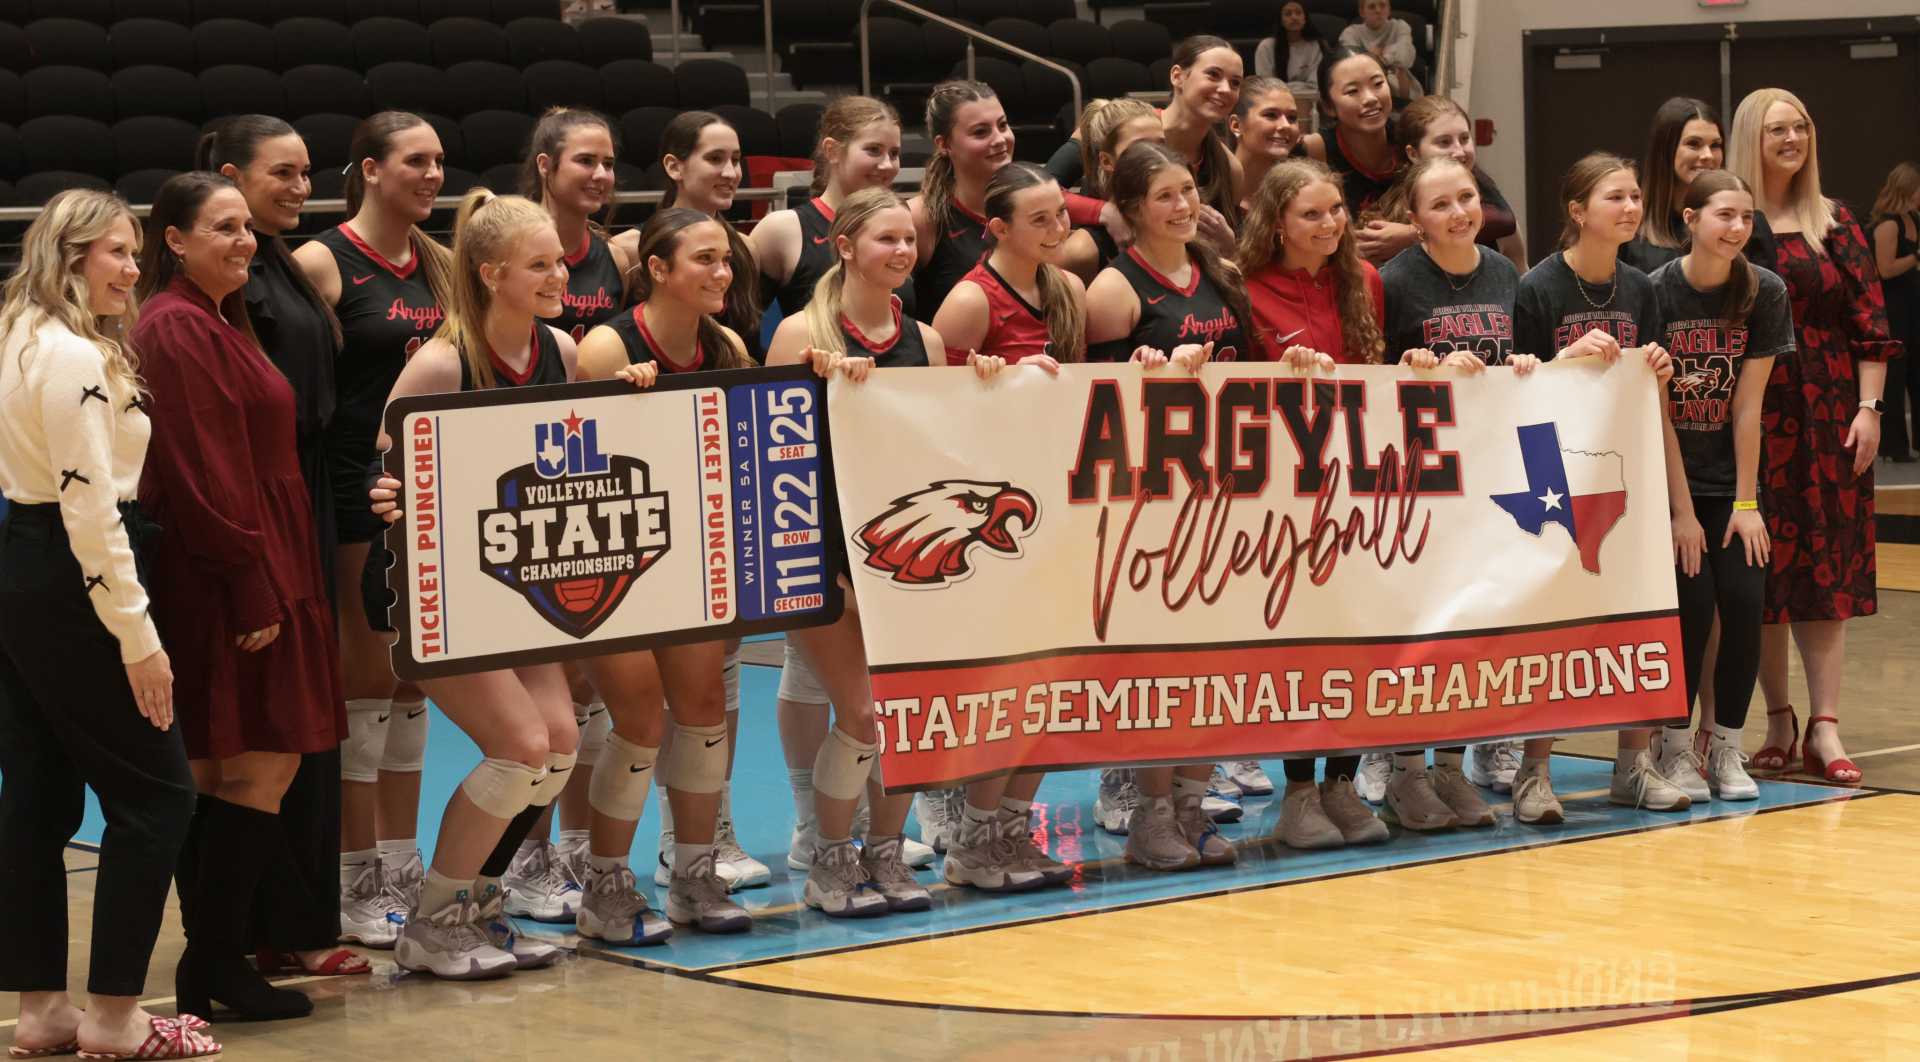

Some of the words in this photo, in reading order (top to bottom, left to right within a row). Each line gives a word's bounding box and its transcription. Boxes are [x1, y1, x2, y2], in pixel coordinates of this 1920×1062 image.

[386, 297, 445, 330] Argyl
[1177, 306, 1237, 342] Argyle
[701, 392, 723, 482] TICKET
[738, 421, 748, 447] D2
[767, 387, 815, 444] 25
[1669, 399, 1728, 423] LAYO
[535, 410, 609, 478] UIL
[779, 446, 806, 459] SEAT
[1068, 378, 1463, 504] ARGYLE
[414, 417, 437, 550] PUNCHED
[525, 478, 624, 505] VOLLEYBALL
[772, 471, 819, 529] 22
[483, 495, 667, 565] STATE
[707, 493, 728, 620] PUNCHED
[741, 499, 755, 585] WINNER
[783, 531, 810, 545] ROW
[1093, 438, 1431, 643] Volleyball
[520, 553, 635, 582] CHAMPIONSHIPS
[776, 555, 820, 594] 11
[418, 562, 441, 658] TICKET
[775, 594, 822, 612] SECTION
[1021, 668, 1354, 736] SEMIFINALS
[1365, 641, 1671, 717] CHAMPIONS
